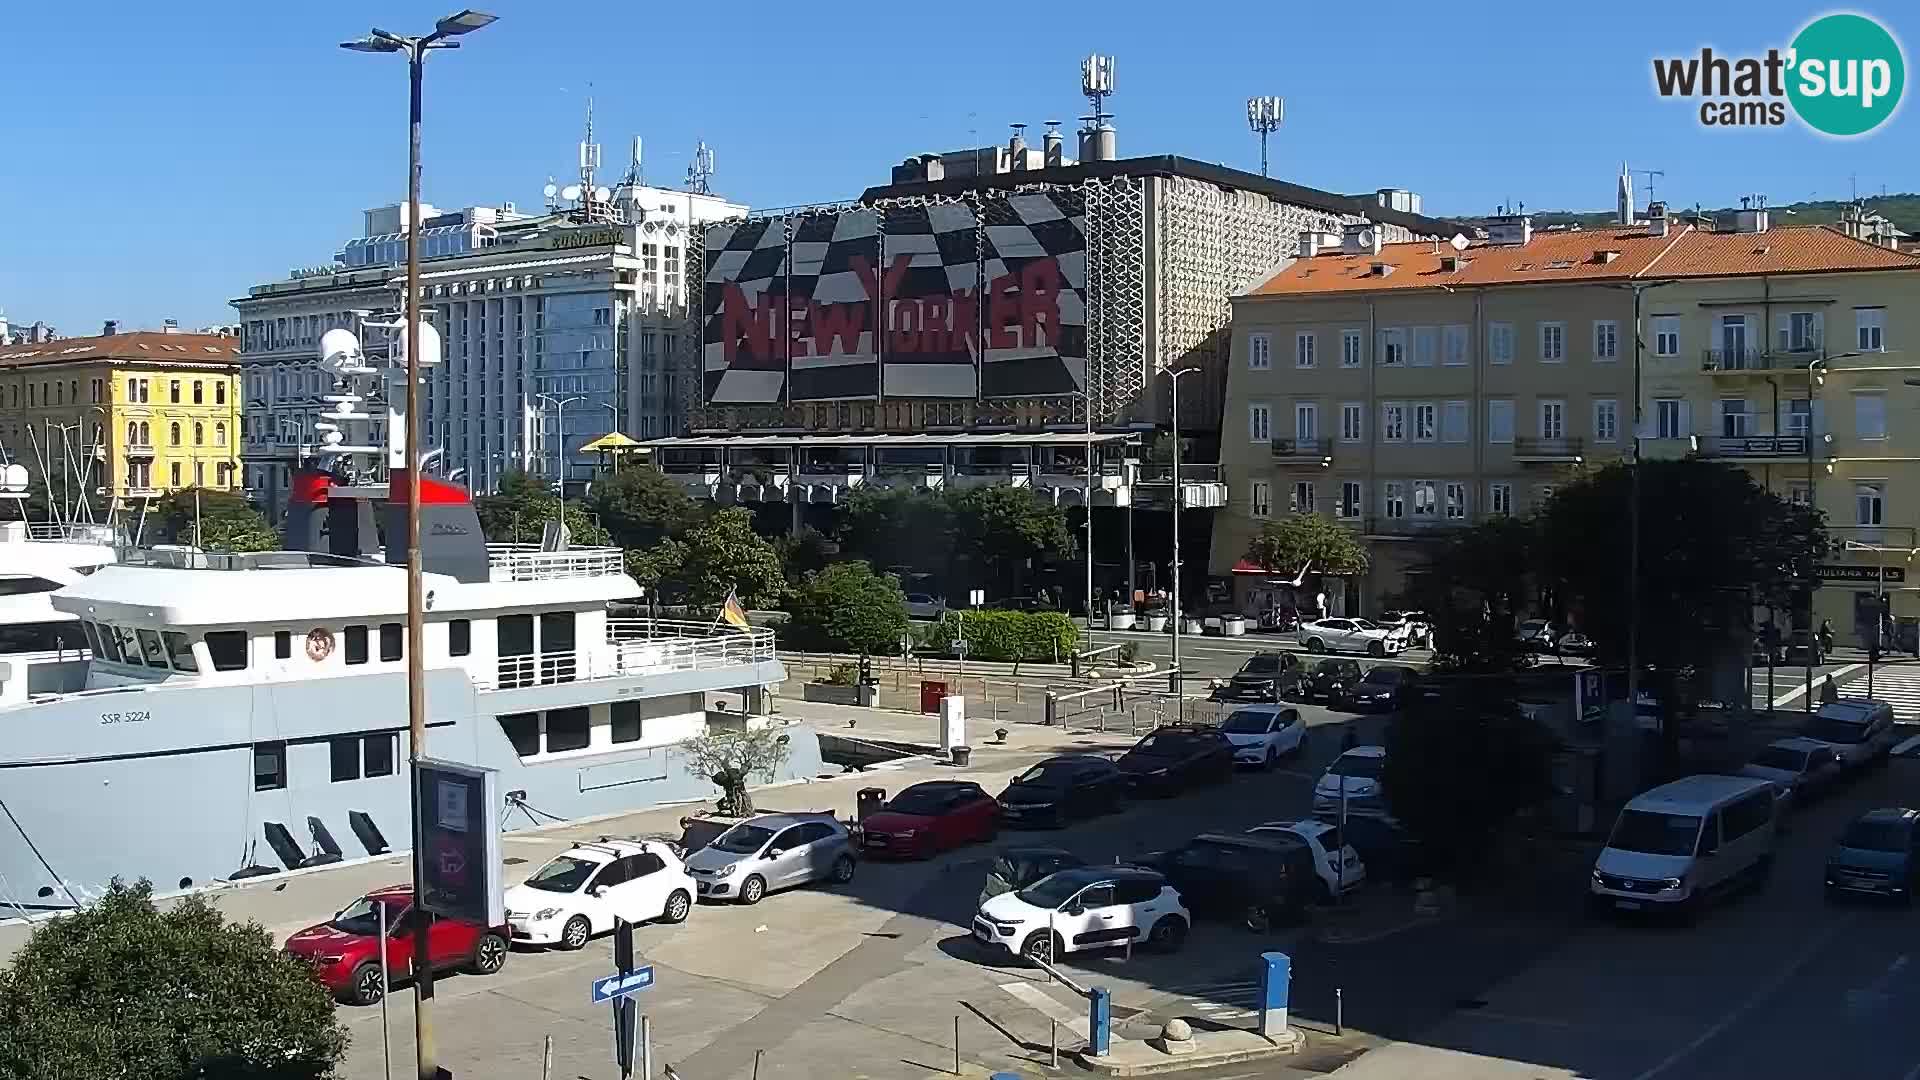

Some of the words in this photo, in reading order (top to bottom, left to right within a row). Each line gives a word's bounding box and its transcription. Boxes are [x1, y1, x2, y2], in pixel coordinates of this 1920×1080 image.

[723, 278, 866, 361] NEW
[850, 254, 1060, 353] YORKER
[1866, 570, 1899, 579] NALS
[101, 713, 121, 725] SSR
[125, 711, 151, 723] 5224
